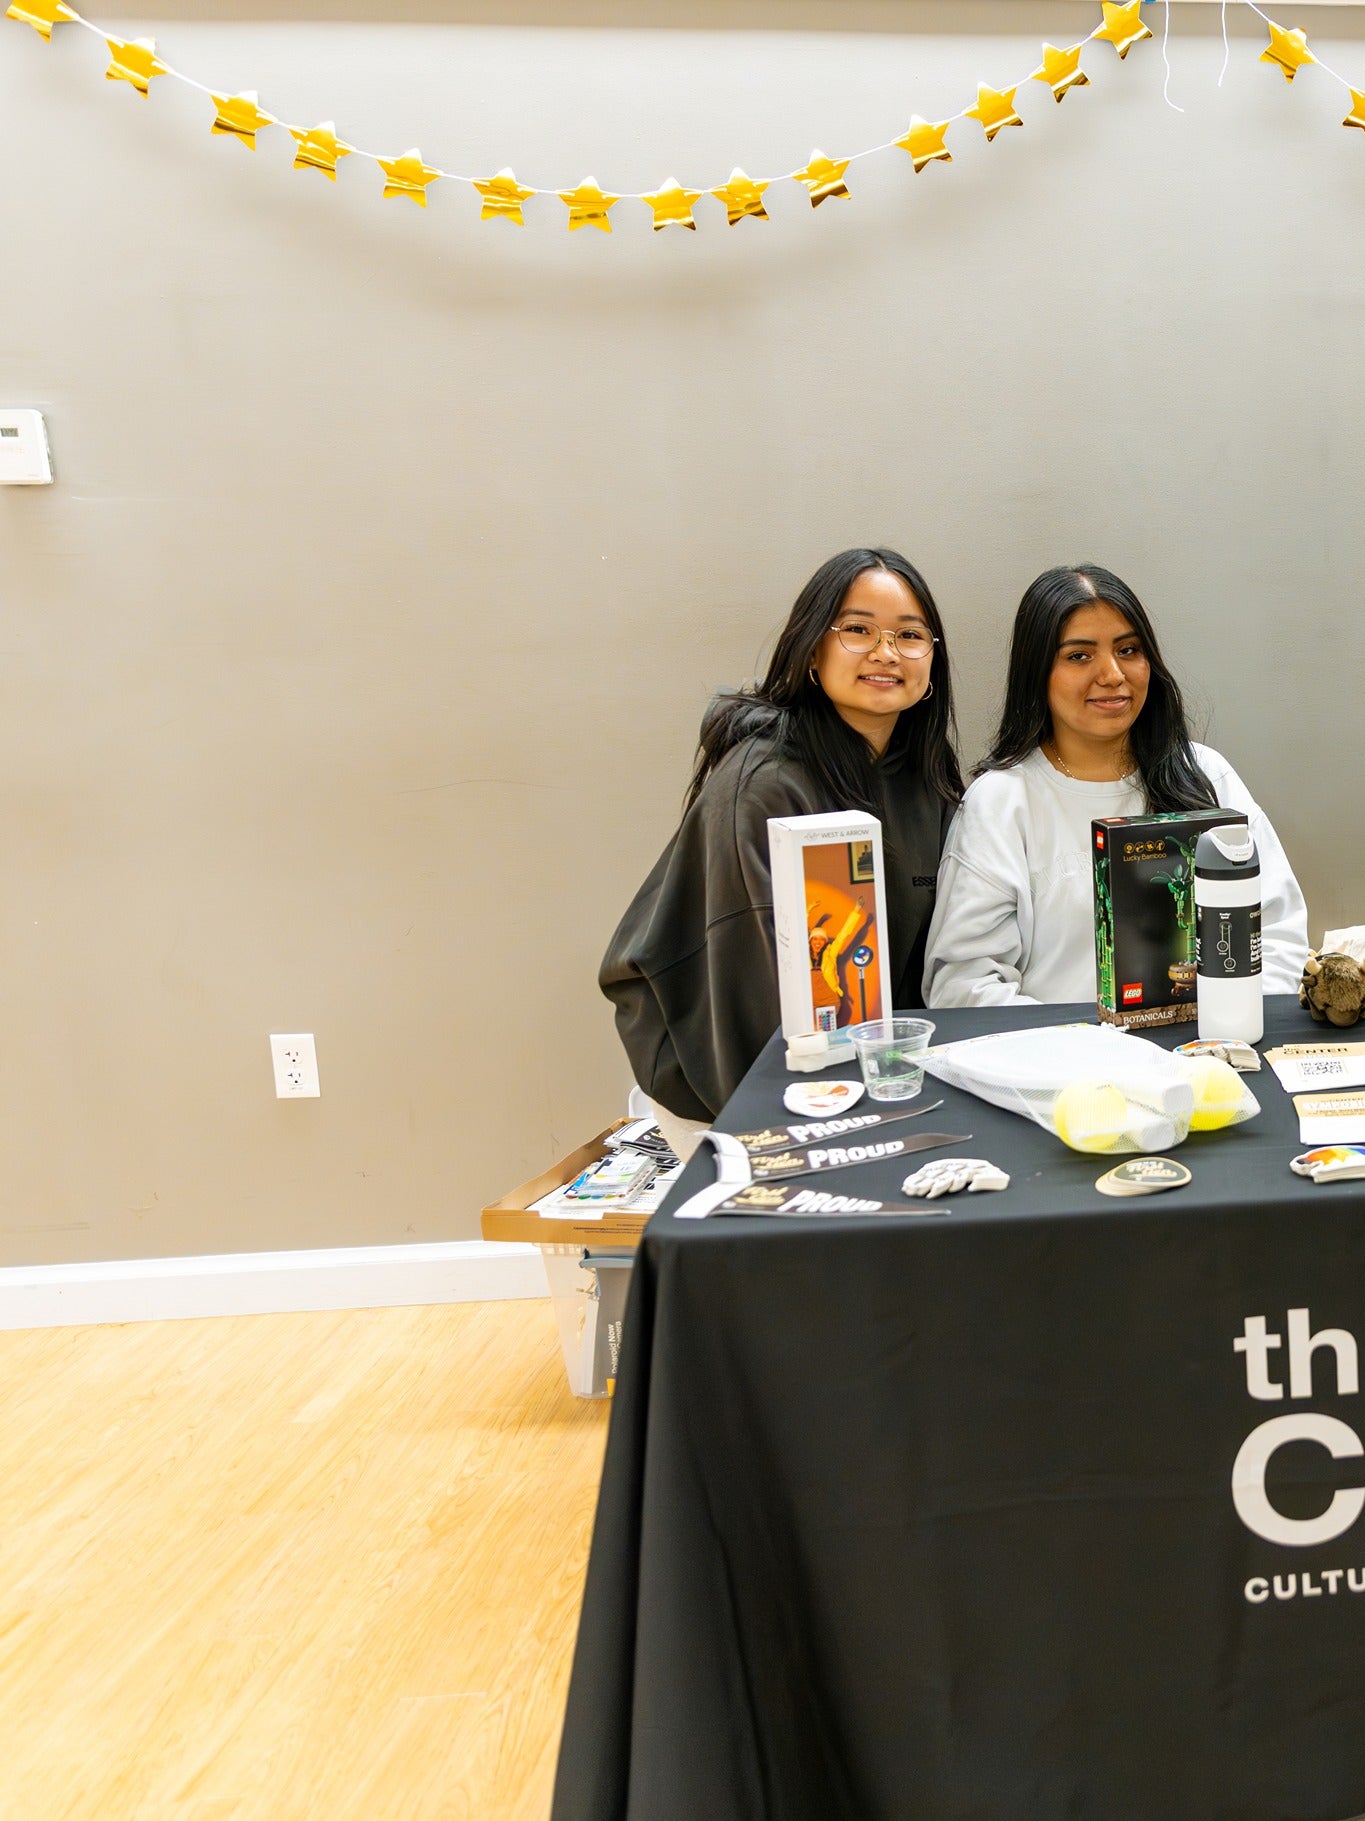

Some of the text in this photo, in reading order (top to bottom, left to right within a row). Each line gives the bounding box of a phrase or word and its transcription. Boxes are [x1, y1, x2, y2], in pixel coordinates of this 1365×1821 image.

[1123, 855, 1140, 864] Lucky
[1125, 988, 1141, 998] LEGO
[1123, 1010, 1174, 1025] BOTANICALS
[787, 1114, 882, 1143] PROUD
[807, 1140, 905, 1169] PROUD
[777, 1190, 883, 1212] PROUD
